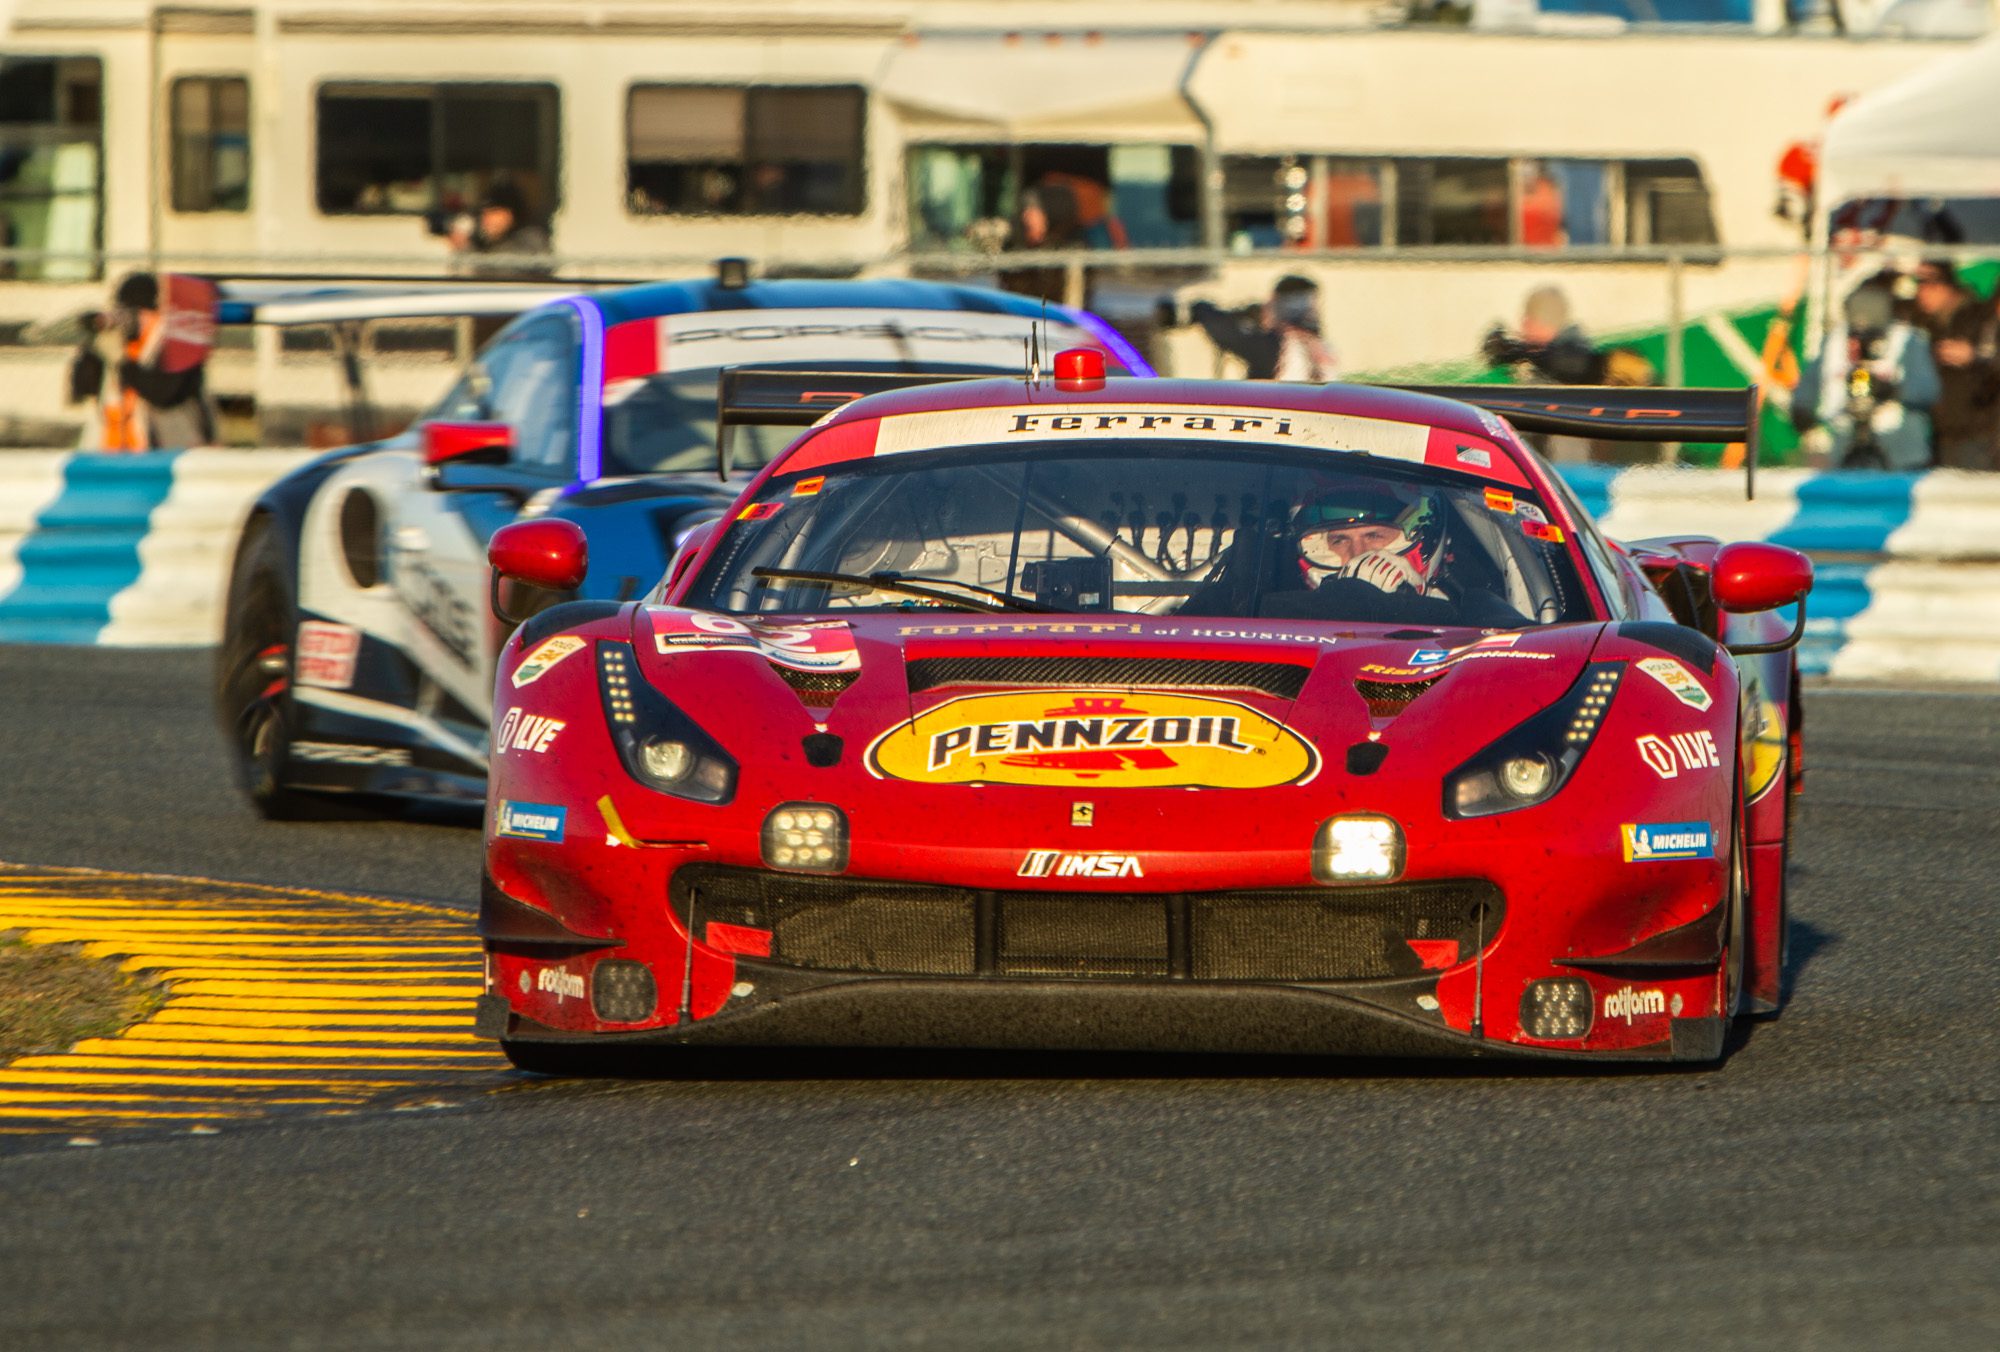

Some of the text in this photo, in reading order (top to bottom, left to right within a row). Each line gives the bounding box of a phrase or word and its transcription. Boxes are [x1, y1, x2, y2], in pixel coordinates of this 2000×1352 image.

[1008, 413, 1293, 436] Ferrari
[895, 623, 1338, 644] Ferrari of HOUSTON
[512, 714, 567, 753] ILVE
[929, 716, 1254, 771] PENNZOIL
[1669, 730, 1720, 769] ILVE
[511, 813, 559, 831] MICHELIN
[1652, 832, 1707, 849] MICHELIN
[1056, 855, 1145, 878] IMSA
[1604, 985, 1665, 1026] rotiform
